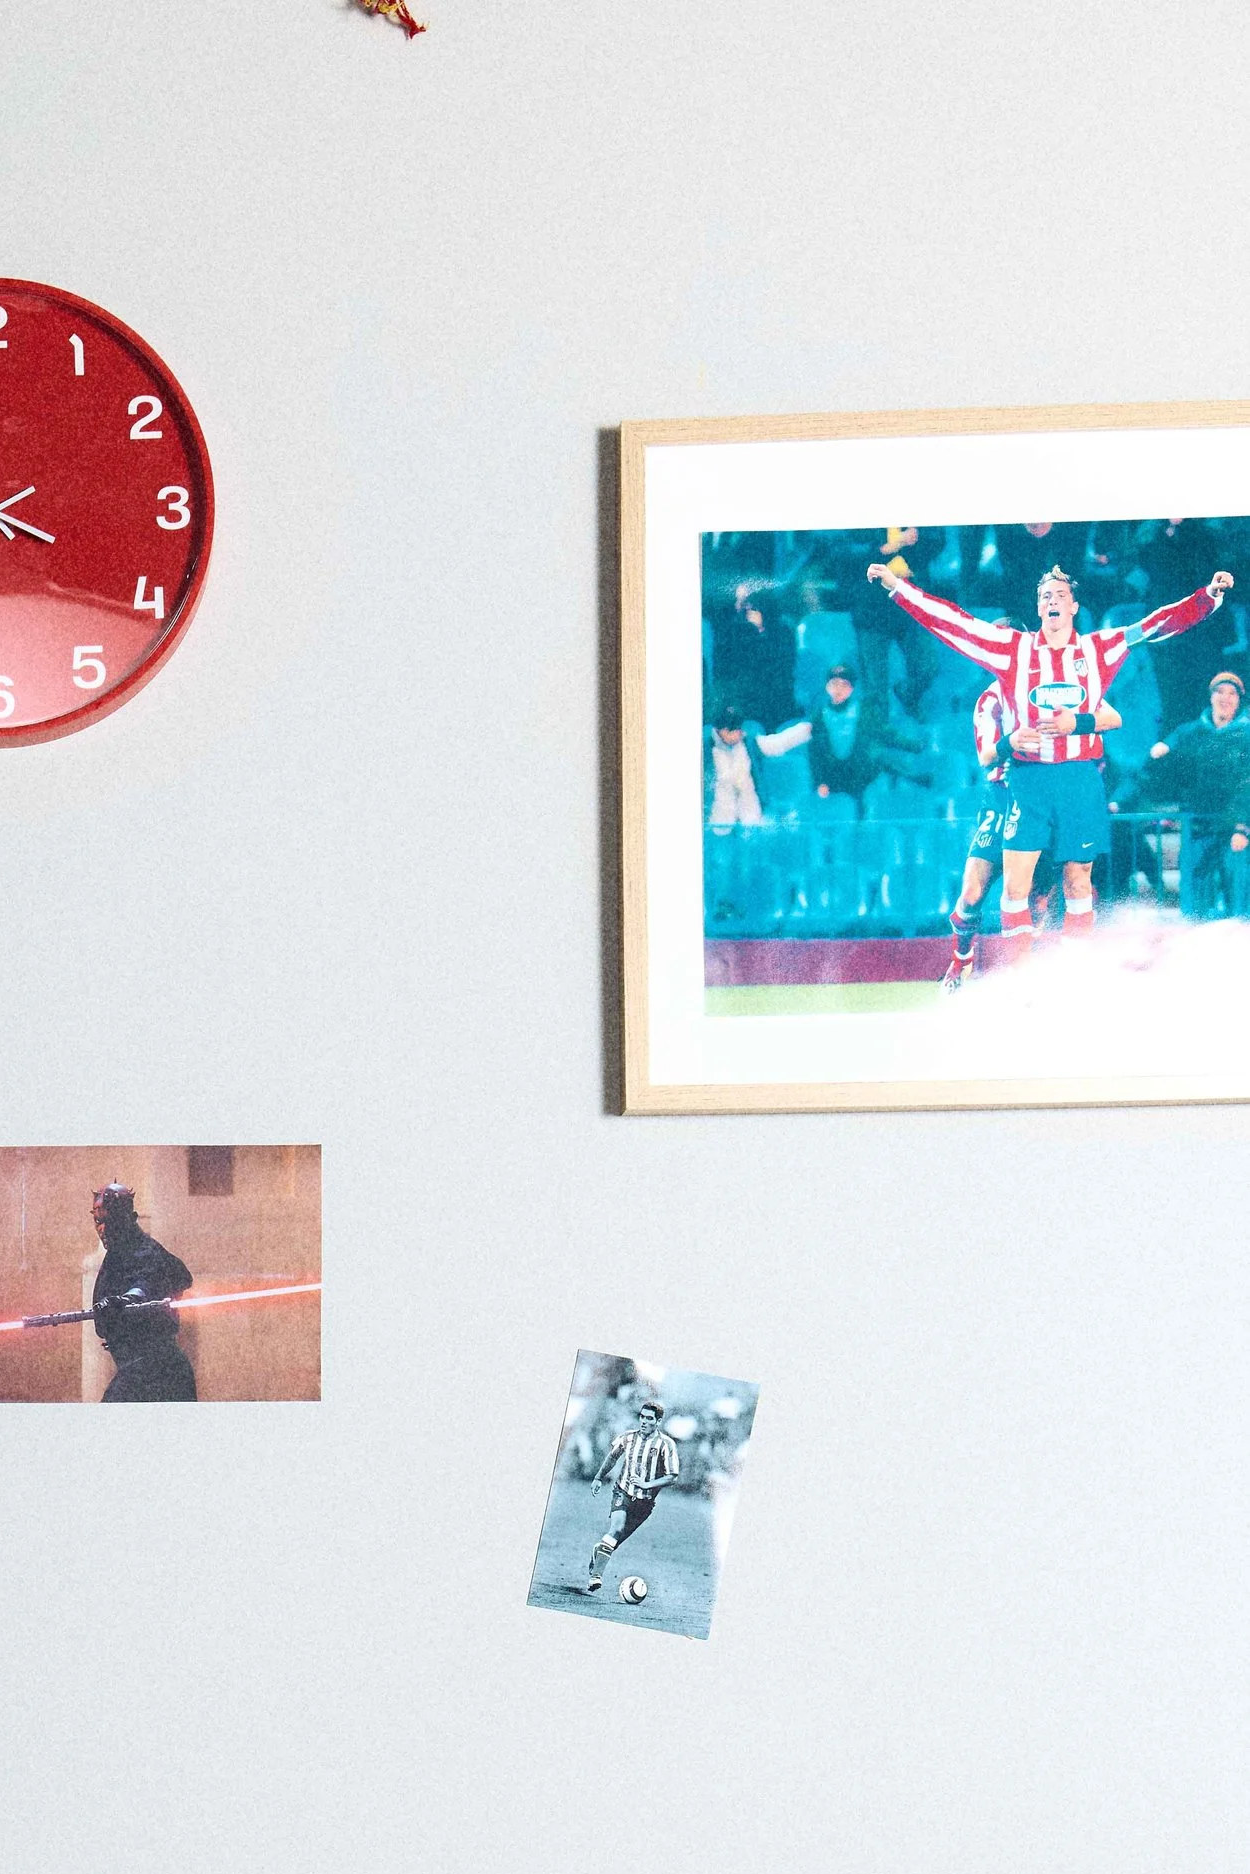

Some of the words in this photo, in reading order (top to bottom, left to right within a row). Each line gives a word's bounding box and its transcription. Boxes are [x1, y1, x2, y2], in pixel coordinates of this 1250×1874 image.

[68, 333, 85, 376] 1
[126, 395, 163, 440] 2
[155, 485, 191, 530] 3
[132, 575, 165, 619] 4
[72, 644, 106, 689] 5
